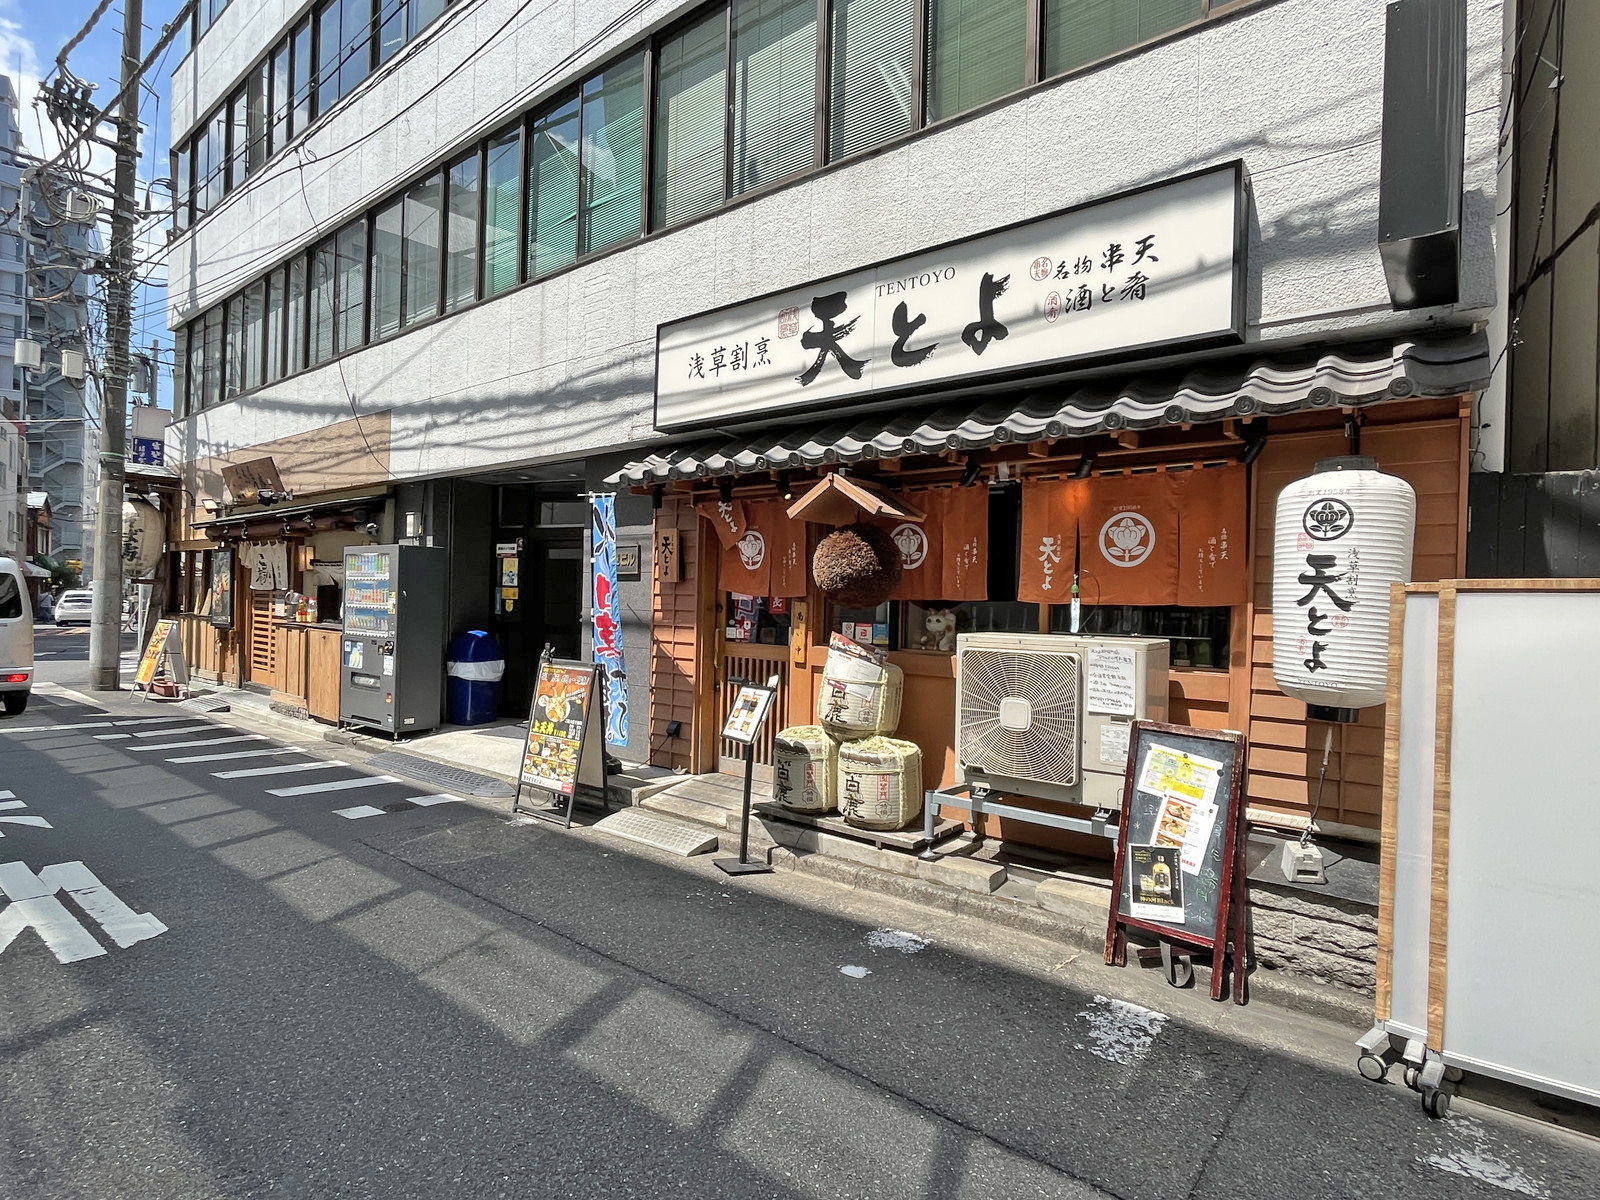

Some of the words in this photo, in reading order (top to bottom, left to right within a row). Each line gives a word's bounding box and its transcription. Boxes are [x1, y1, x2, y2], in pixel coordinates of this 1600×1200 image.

[1053, 234, 1159, 281] 名物串天
[876, 267, 956, 297] TENTOYO
[1064, 271, 1149, 314] 酒と肴
[795, 272, 1010, 387] 天とよ
[688, 337, 771, 379] 浅草割烹
[660, 535, 673, 577] 天とよ
[1038, 536, 1061, 591] 天とよ
[1293, 553, 1360, 673] 天とよ
